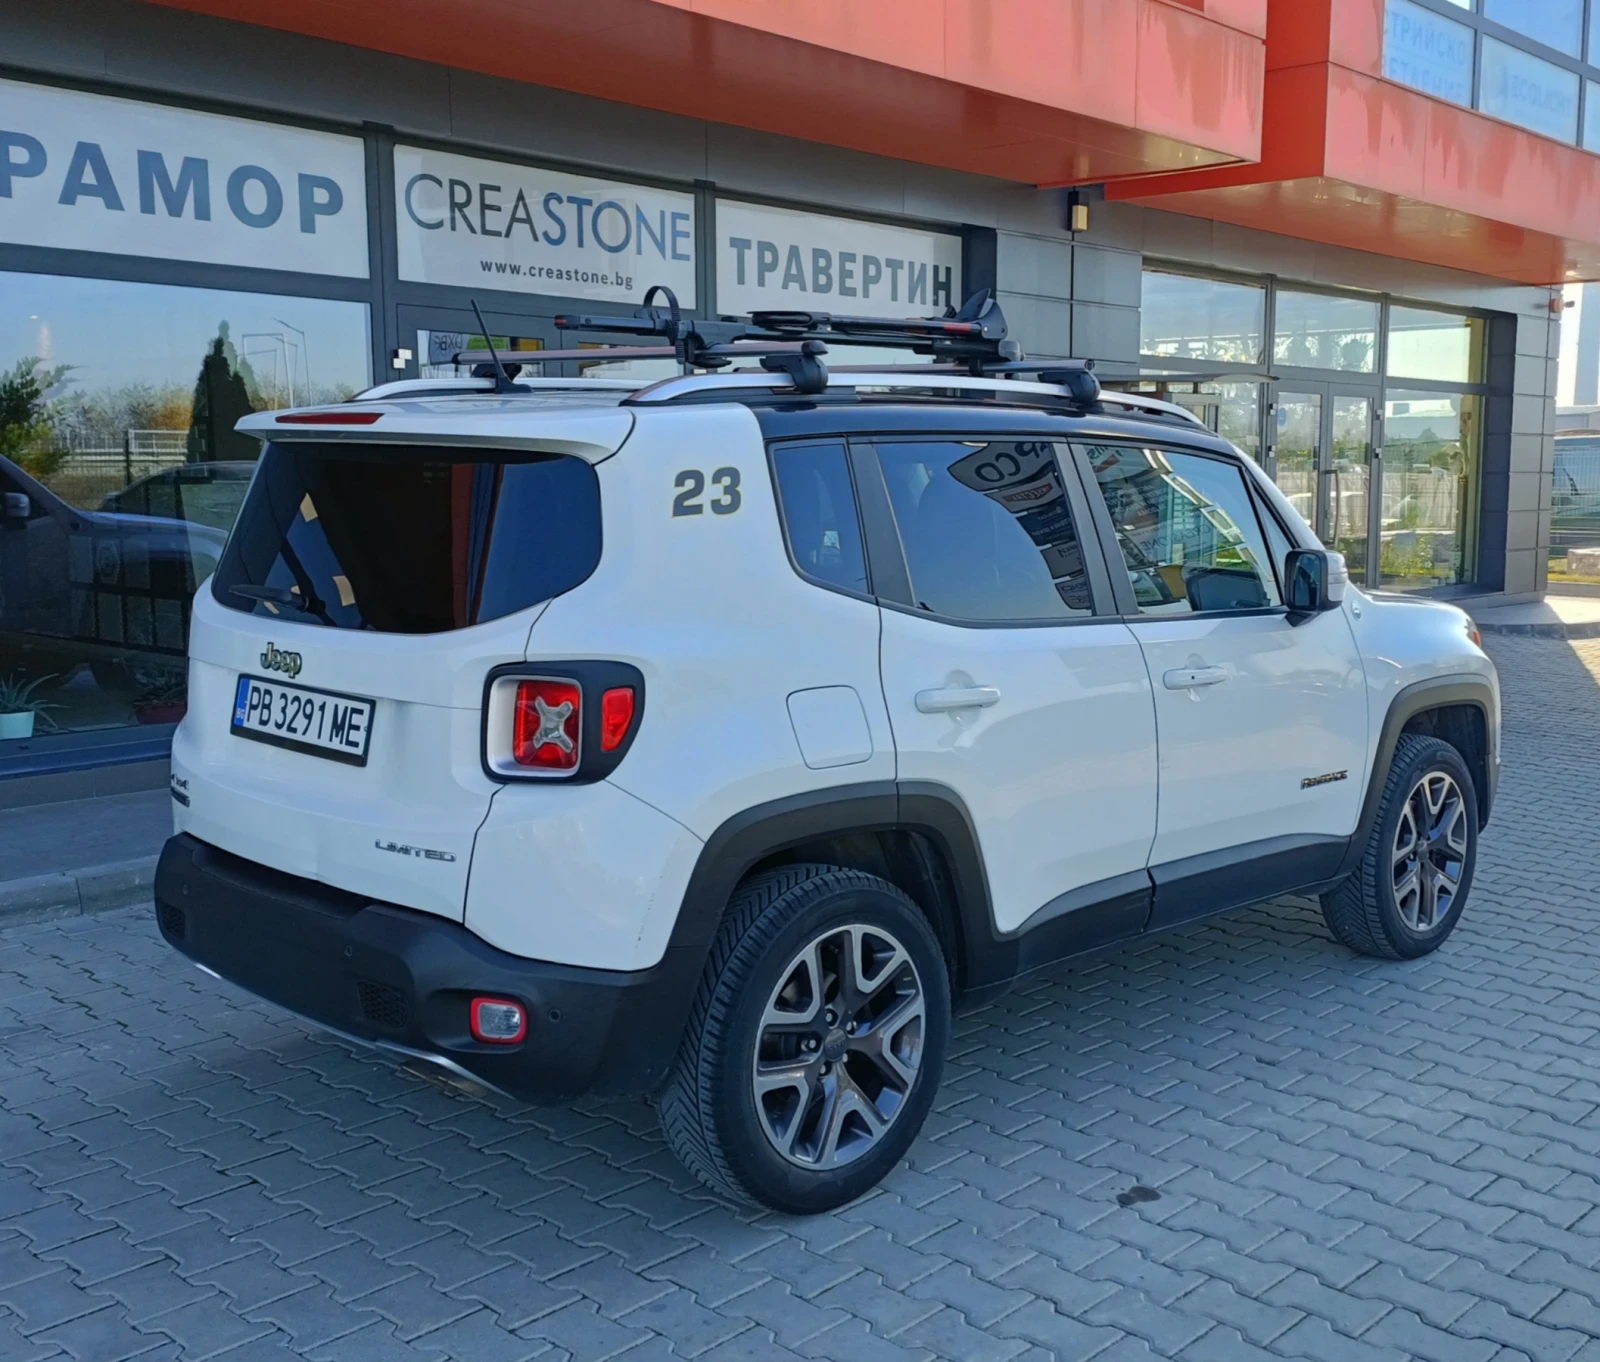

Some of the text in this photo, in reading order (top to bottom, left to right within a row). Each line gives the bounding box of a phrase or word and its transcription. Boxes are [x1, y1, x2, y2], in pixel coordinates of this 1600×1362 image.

[404, 173, 691, 262] CREASTONE
[480, 259, 634, 290] www.creastone.bg
[729, 236, 952, 307] ТРАВЕРТИН
[671, 466, 742, 518] 23
[260, 641, 303, 680] Jeep
